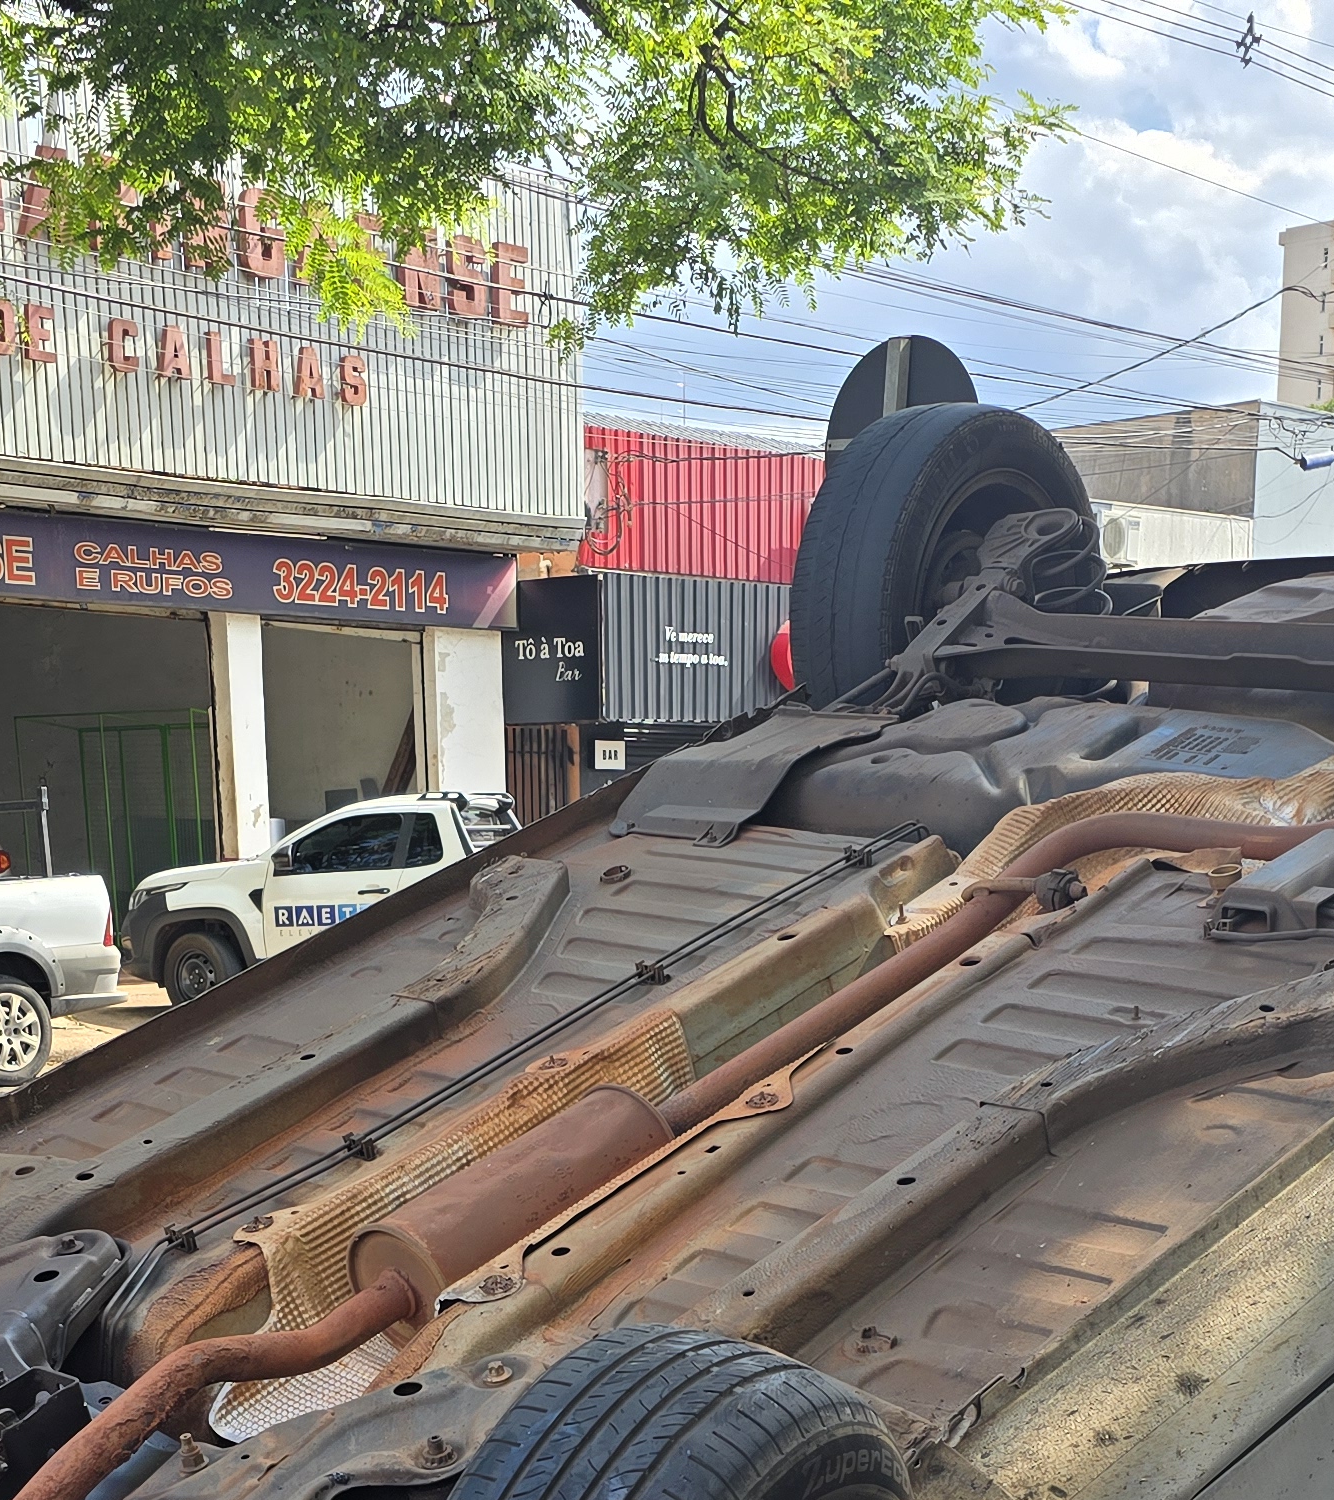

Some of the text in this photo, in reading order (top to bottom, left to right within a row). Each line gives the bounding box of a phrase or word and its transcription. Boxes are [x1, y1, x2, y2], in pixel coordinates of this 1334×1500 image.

[108, 318, 368, 407] CALHAS
[73, 541, 222, 573] CALHAS
[76, 567, 233, 600] E RUFOS
[272, 558, 449, 615] 3224-2114
[515, 637, 585, 660] Tô à Toa
[678, 632, 715, 644] merece
[670, 652, 699, 668] tempo
[555, 661, 583, 682] Bar
[602, 749, 619, 761] BAR
[277, 905, 369, 925] RAET
[279, 928, 322, 937] ELEV
